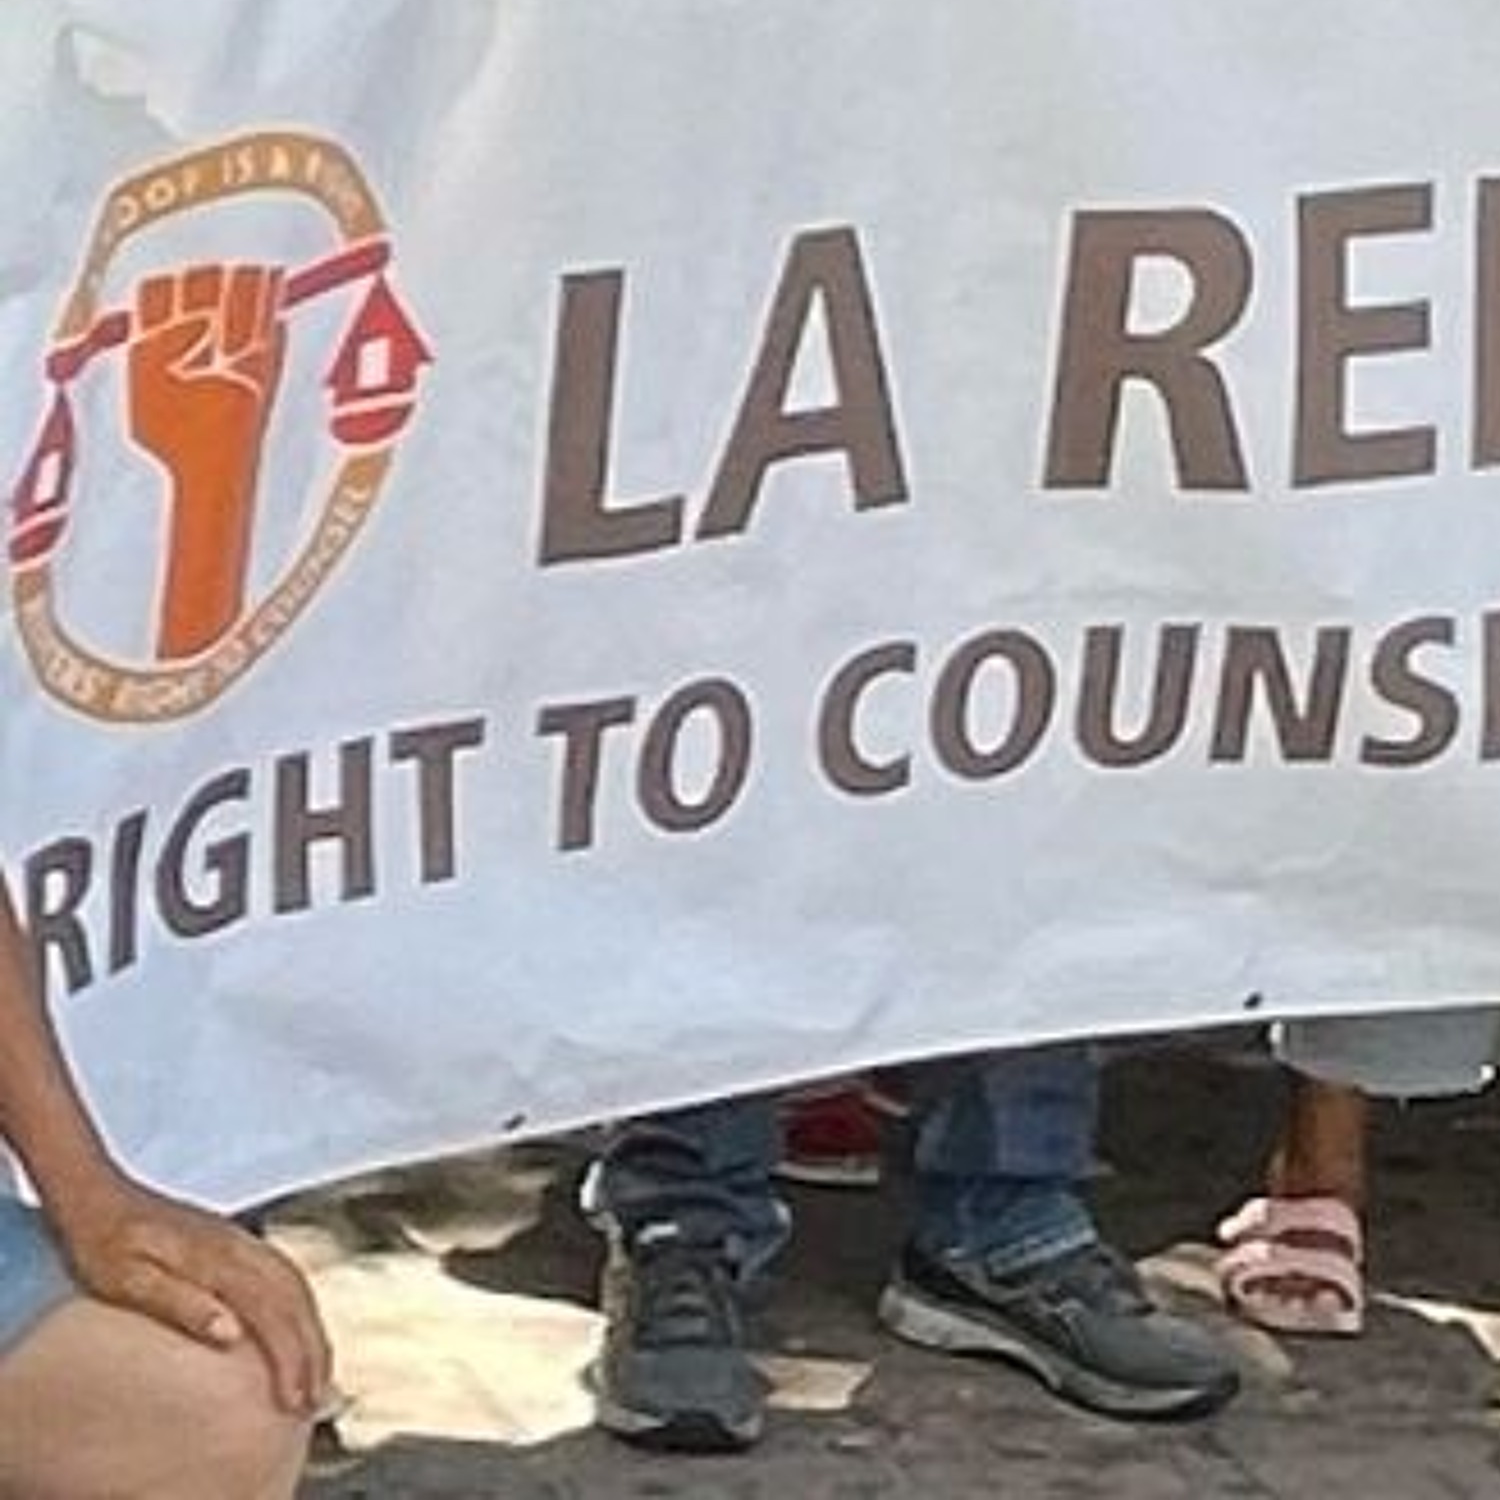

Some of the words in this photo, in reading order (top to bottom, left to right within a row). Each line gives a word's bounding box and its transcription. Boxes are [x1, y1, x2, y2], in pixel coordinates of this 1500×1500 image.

[536, 225, 911, 567] LA
[22, 717, 486, 996] RIGHT
[536, 678, 754, 852] TO
